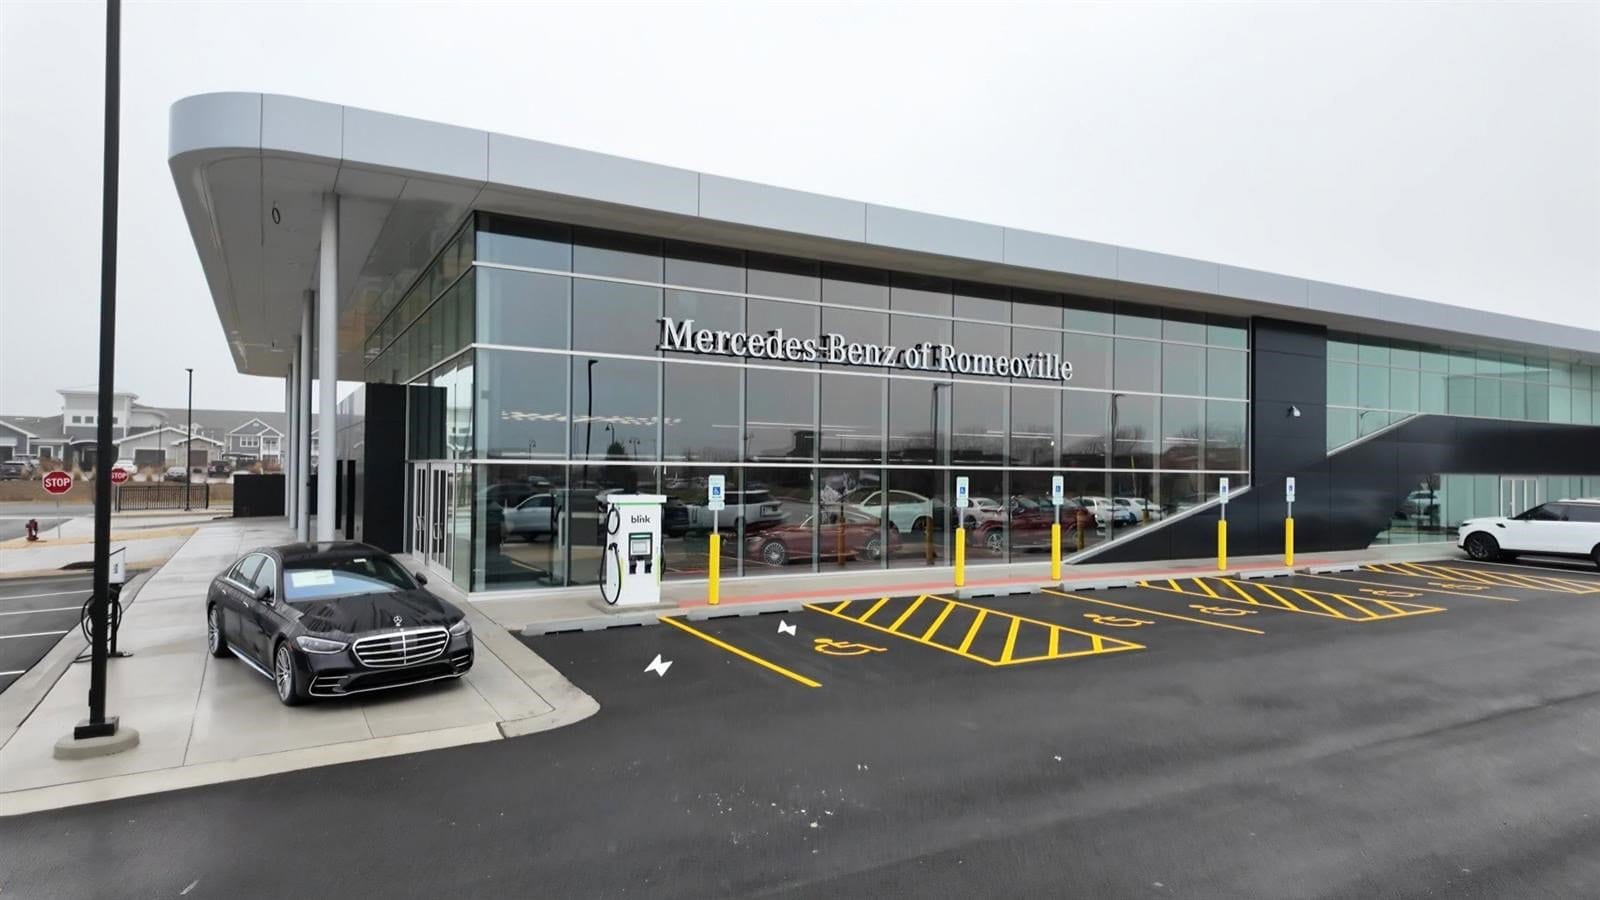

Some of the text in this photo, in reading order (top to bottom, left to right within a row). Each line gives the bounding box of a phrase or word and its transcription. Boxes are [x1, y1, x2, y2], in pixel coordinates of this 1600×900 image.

[659, 317, 1073, 381] Mercedes-Benz of Romeoville
[45, 478, 71, 488] STOP
[630, 514, 651, 524] blink
